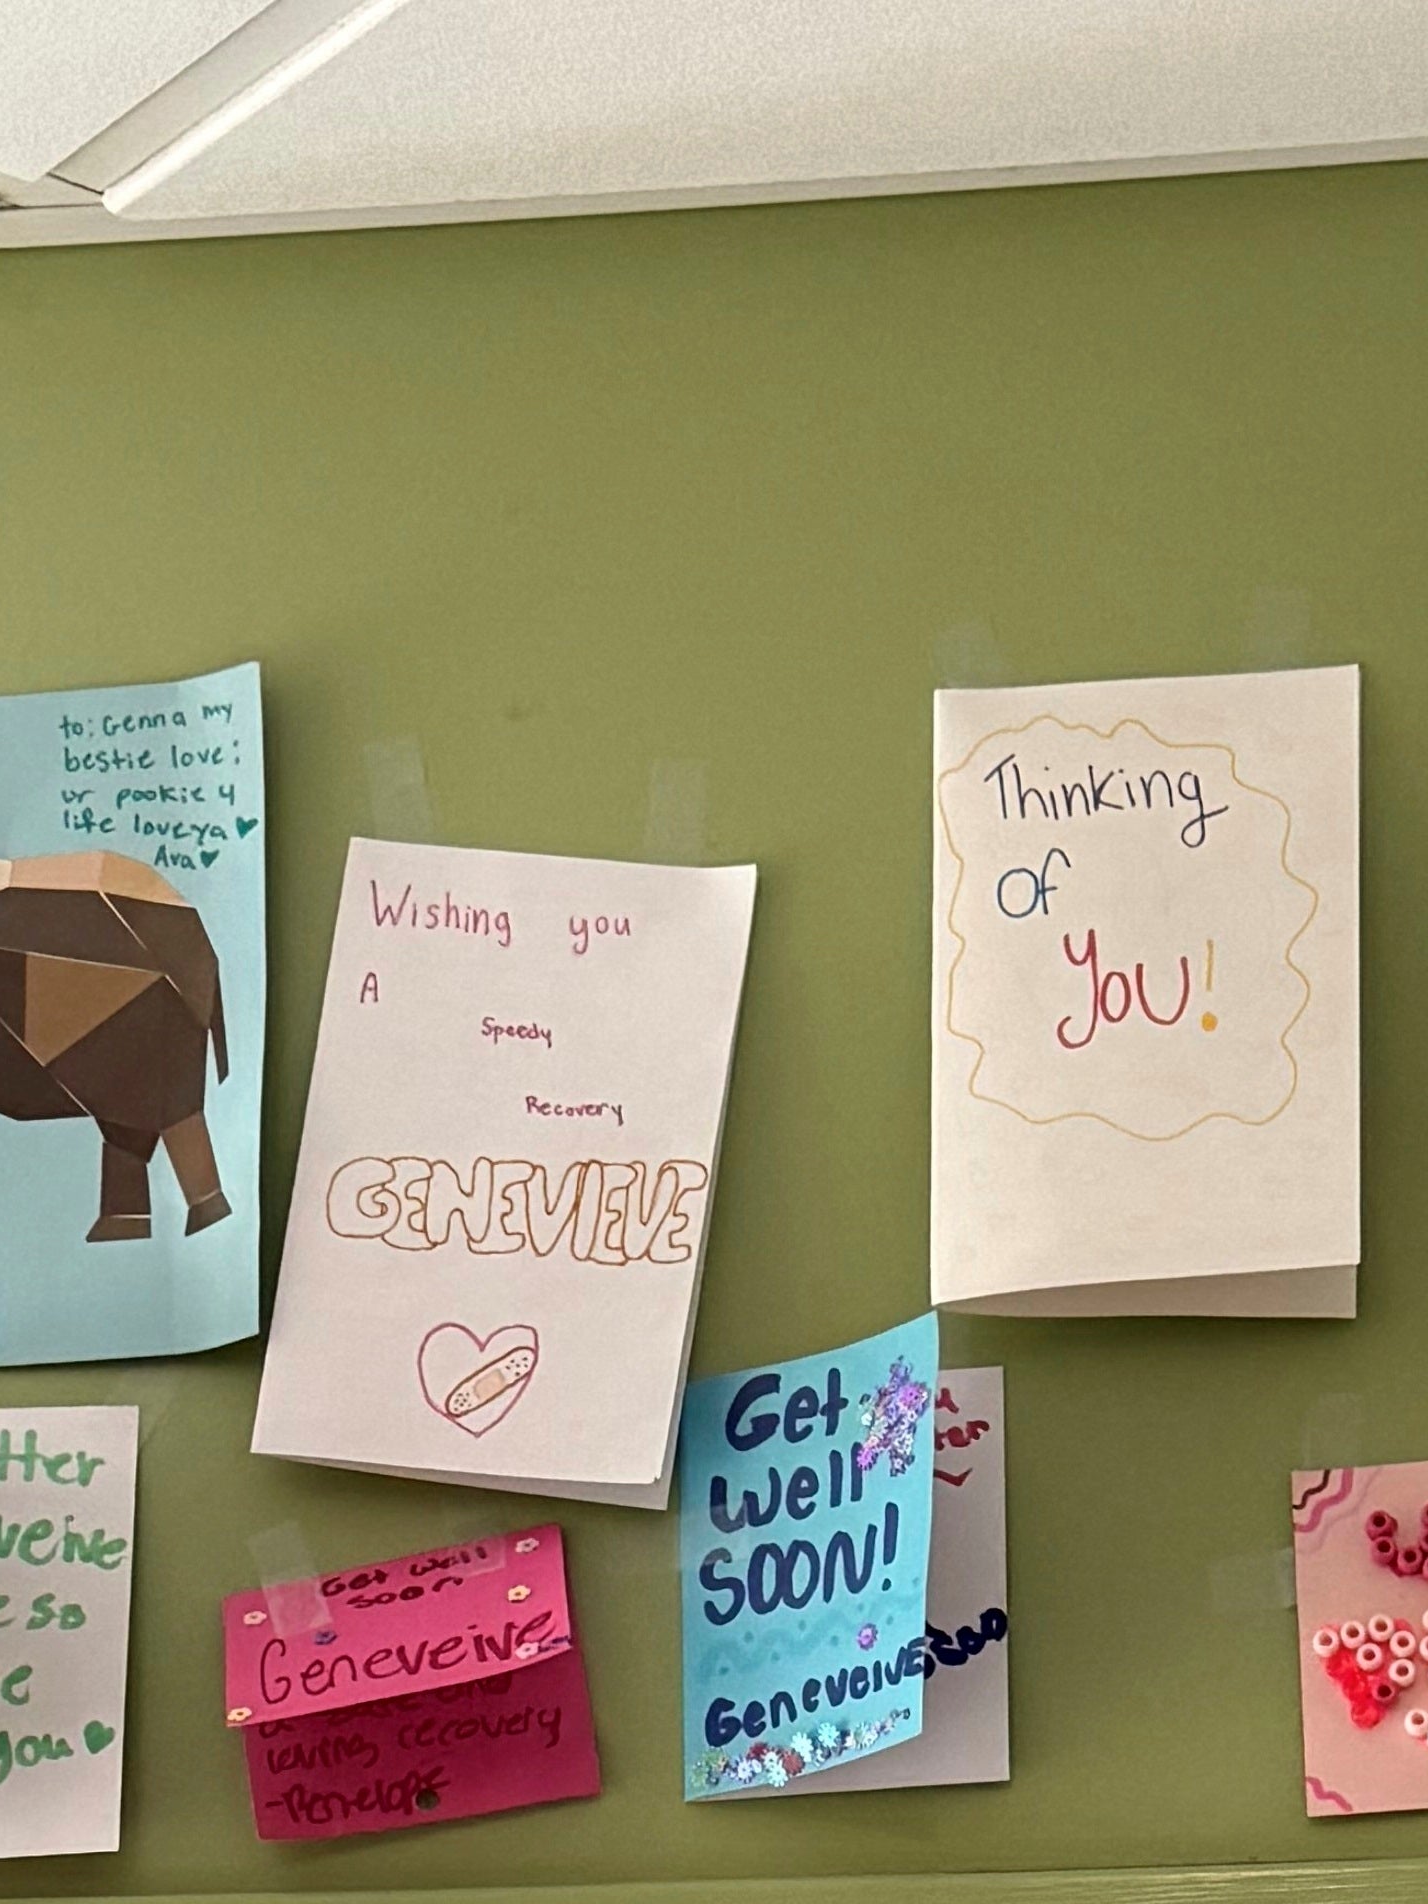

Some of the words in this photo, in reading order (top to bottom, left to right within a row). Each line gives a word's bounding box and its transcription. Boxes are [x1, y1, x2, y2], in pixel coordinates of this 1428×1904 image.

[103, 711, 187, 737] Genna
[202, 703, 233, 723] my
[64, 747, 155, 773] bestie
[116, 785, 205, 809] pookie
[984, 753, 1229, 848] Thinking
[64, 808, 116, 833] life
[154, 845, 196, 869] Ava
[370, 879, 512, 947] Wishing
[569, 915, 631, 953] you
[360, 972, 380, 1004] A
[481, 1017, 552, 1047] Speedy
[526, 1095, 624, 1125] Recovery
[725, 1367, 848, 1451] Get
[698, 1502, 899, 1626] SOON!
[259, 1610, 556, 1704] Geneveive
